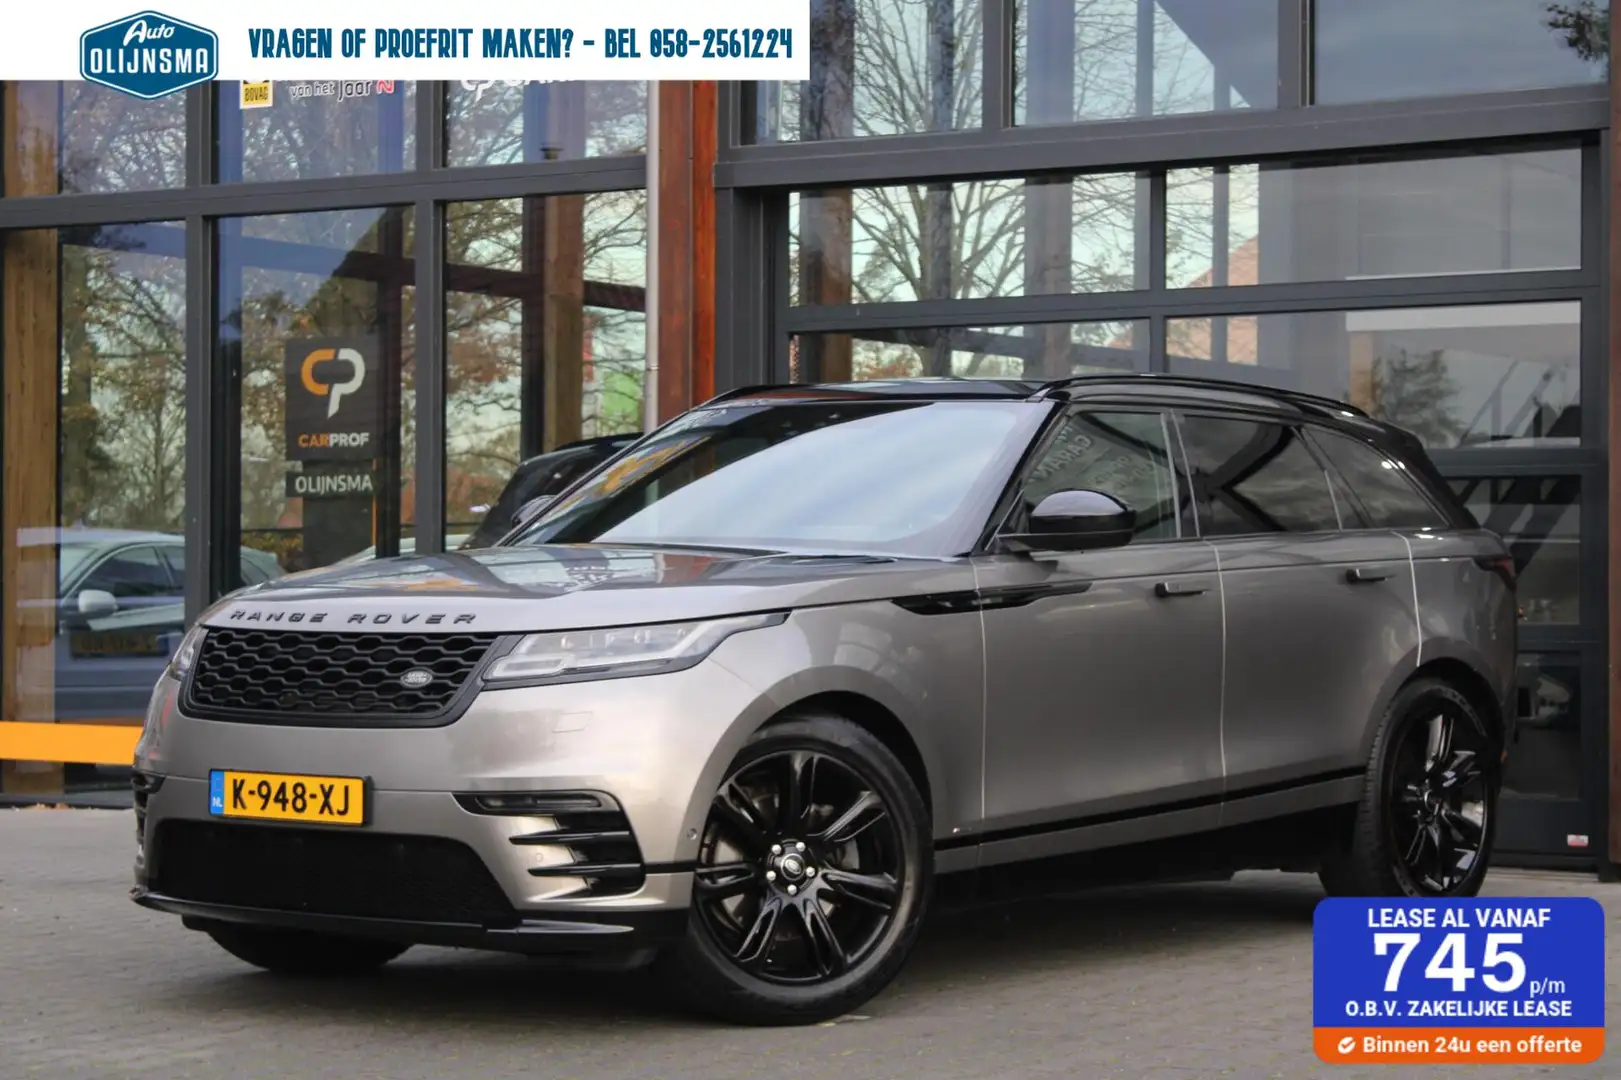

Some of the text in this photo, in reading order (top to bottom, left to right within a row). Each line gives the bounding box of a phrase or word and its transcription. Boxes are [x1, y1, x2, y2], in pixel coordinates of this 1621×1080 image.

[244, 86, 269, 102] BOVAG
[290, 84, 312, 99] van
[314, 81, 335, 96] het
[298, 432, 370, 448] CARPROF
[295, 474, 373, 495] OLIJNSMA
[229, 610, 477, 625] RANGE ROVER
[232, 778, 349, 817] K-948-XJ
